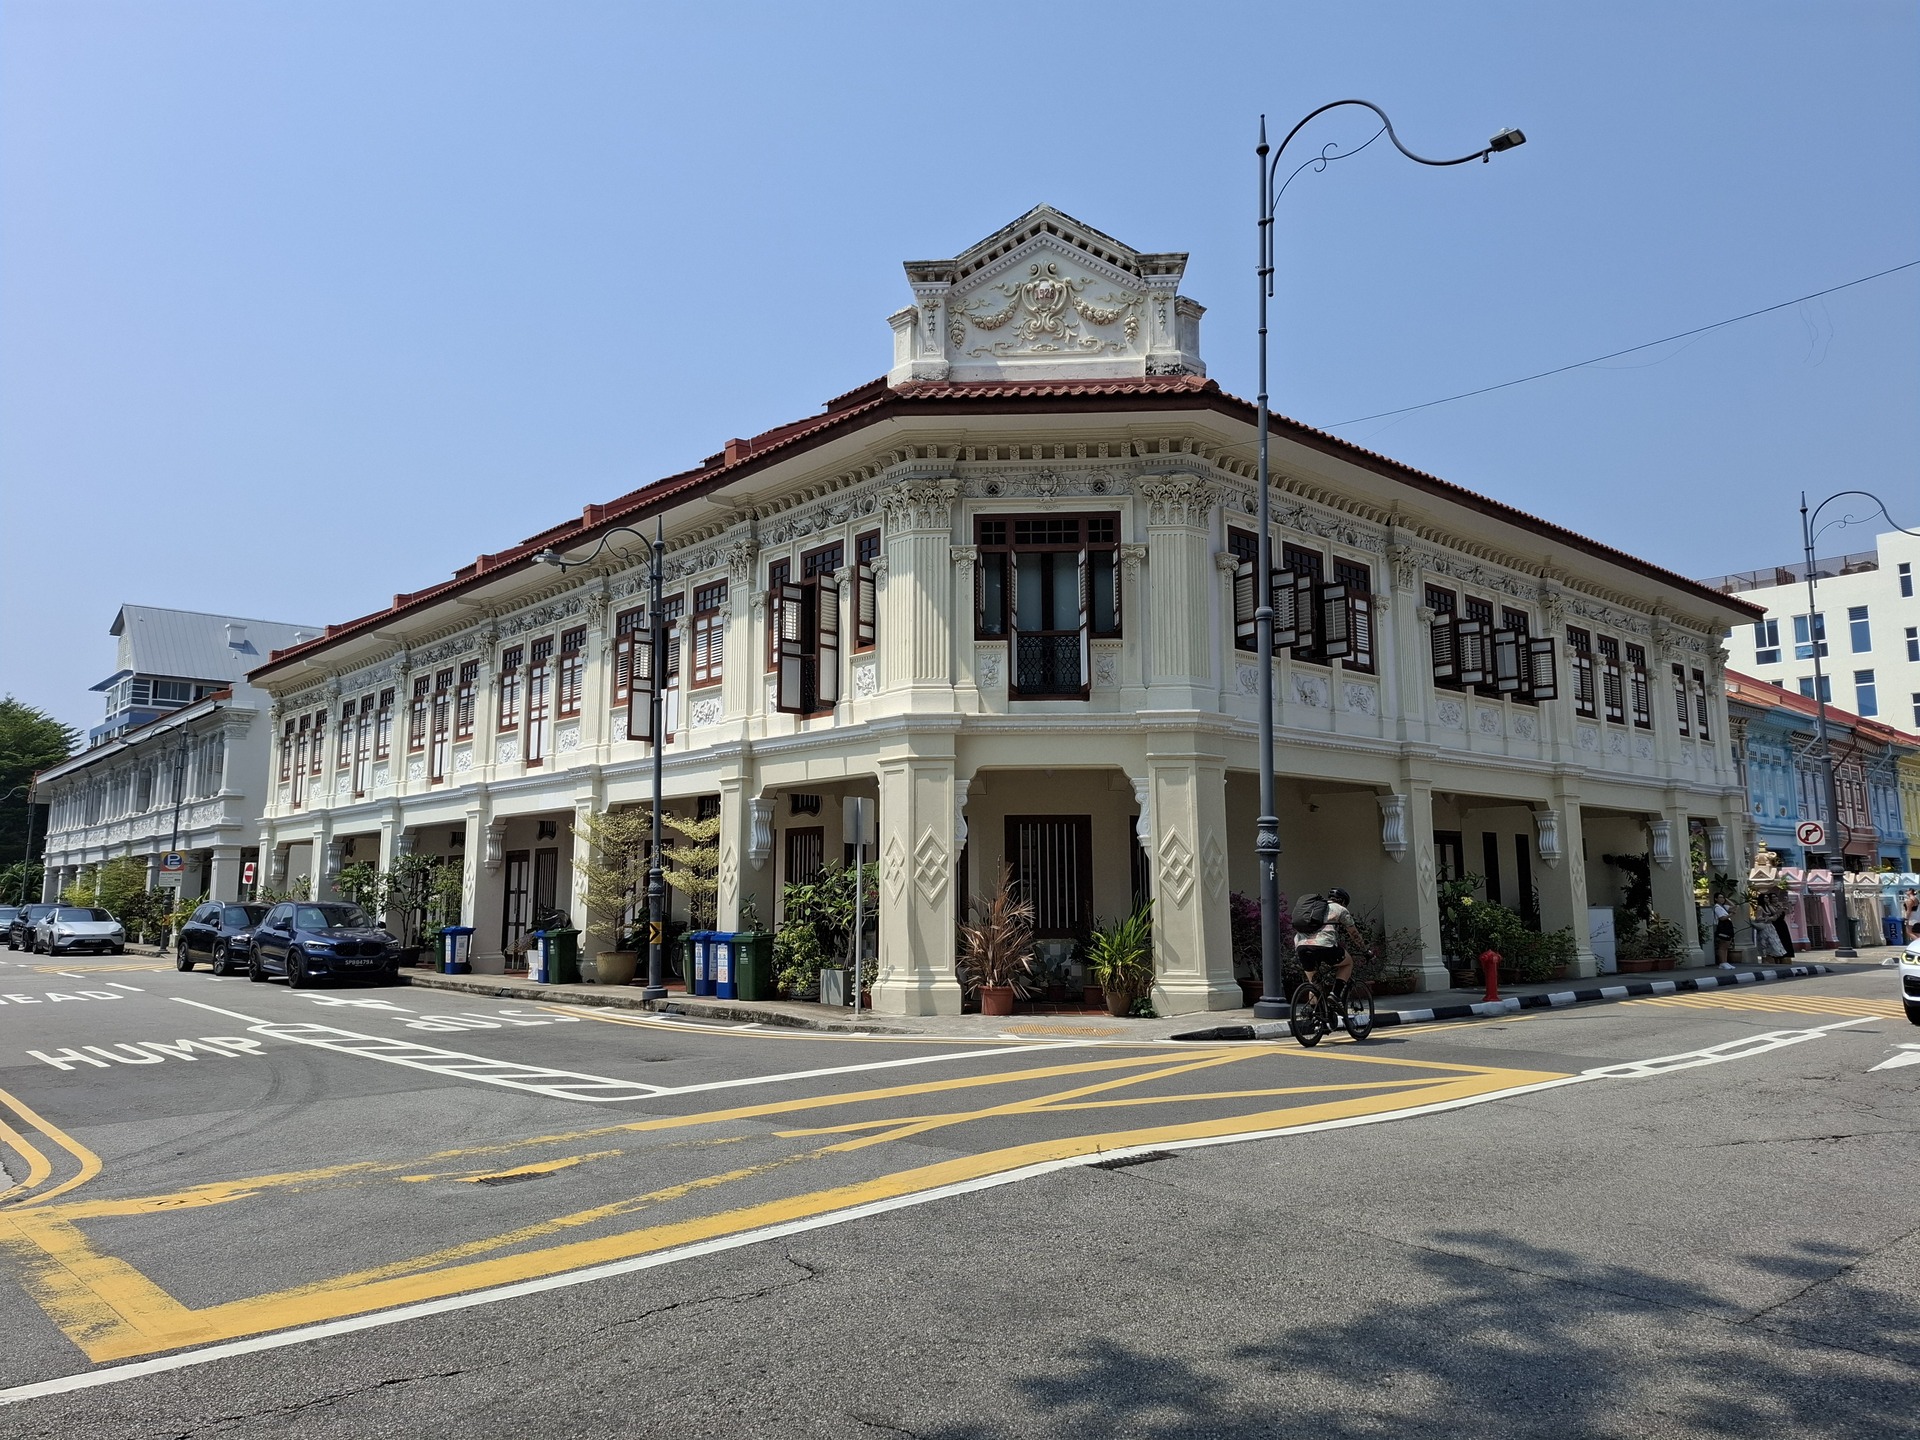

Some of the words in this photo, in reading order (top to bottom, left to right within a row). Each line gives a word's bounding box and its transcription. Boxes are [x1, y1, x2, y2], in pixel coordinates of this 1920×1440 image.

[1034, 288, 1055, 300] 1928
[0, 991, 124, 1005] EAD
[391, 1010, 581, 1032] STOP
[26, 1037, 268, 1071] HUMP
